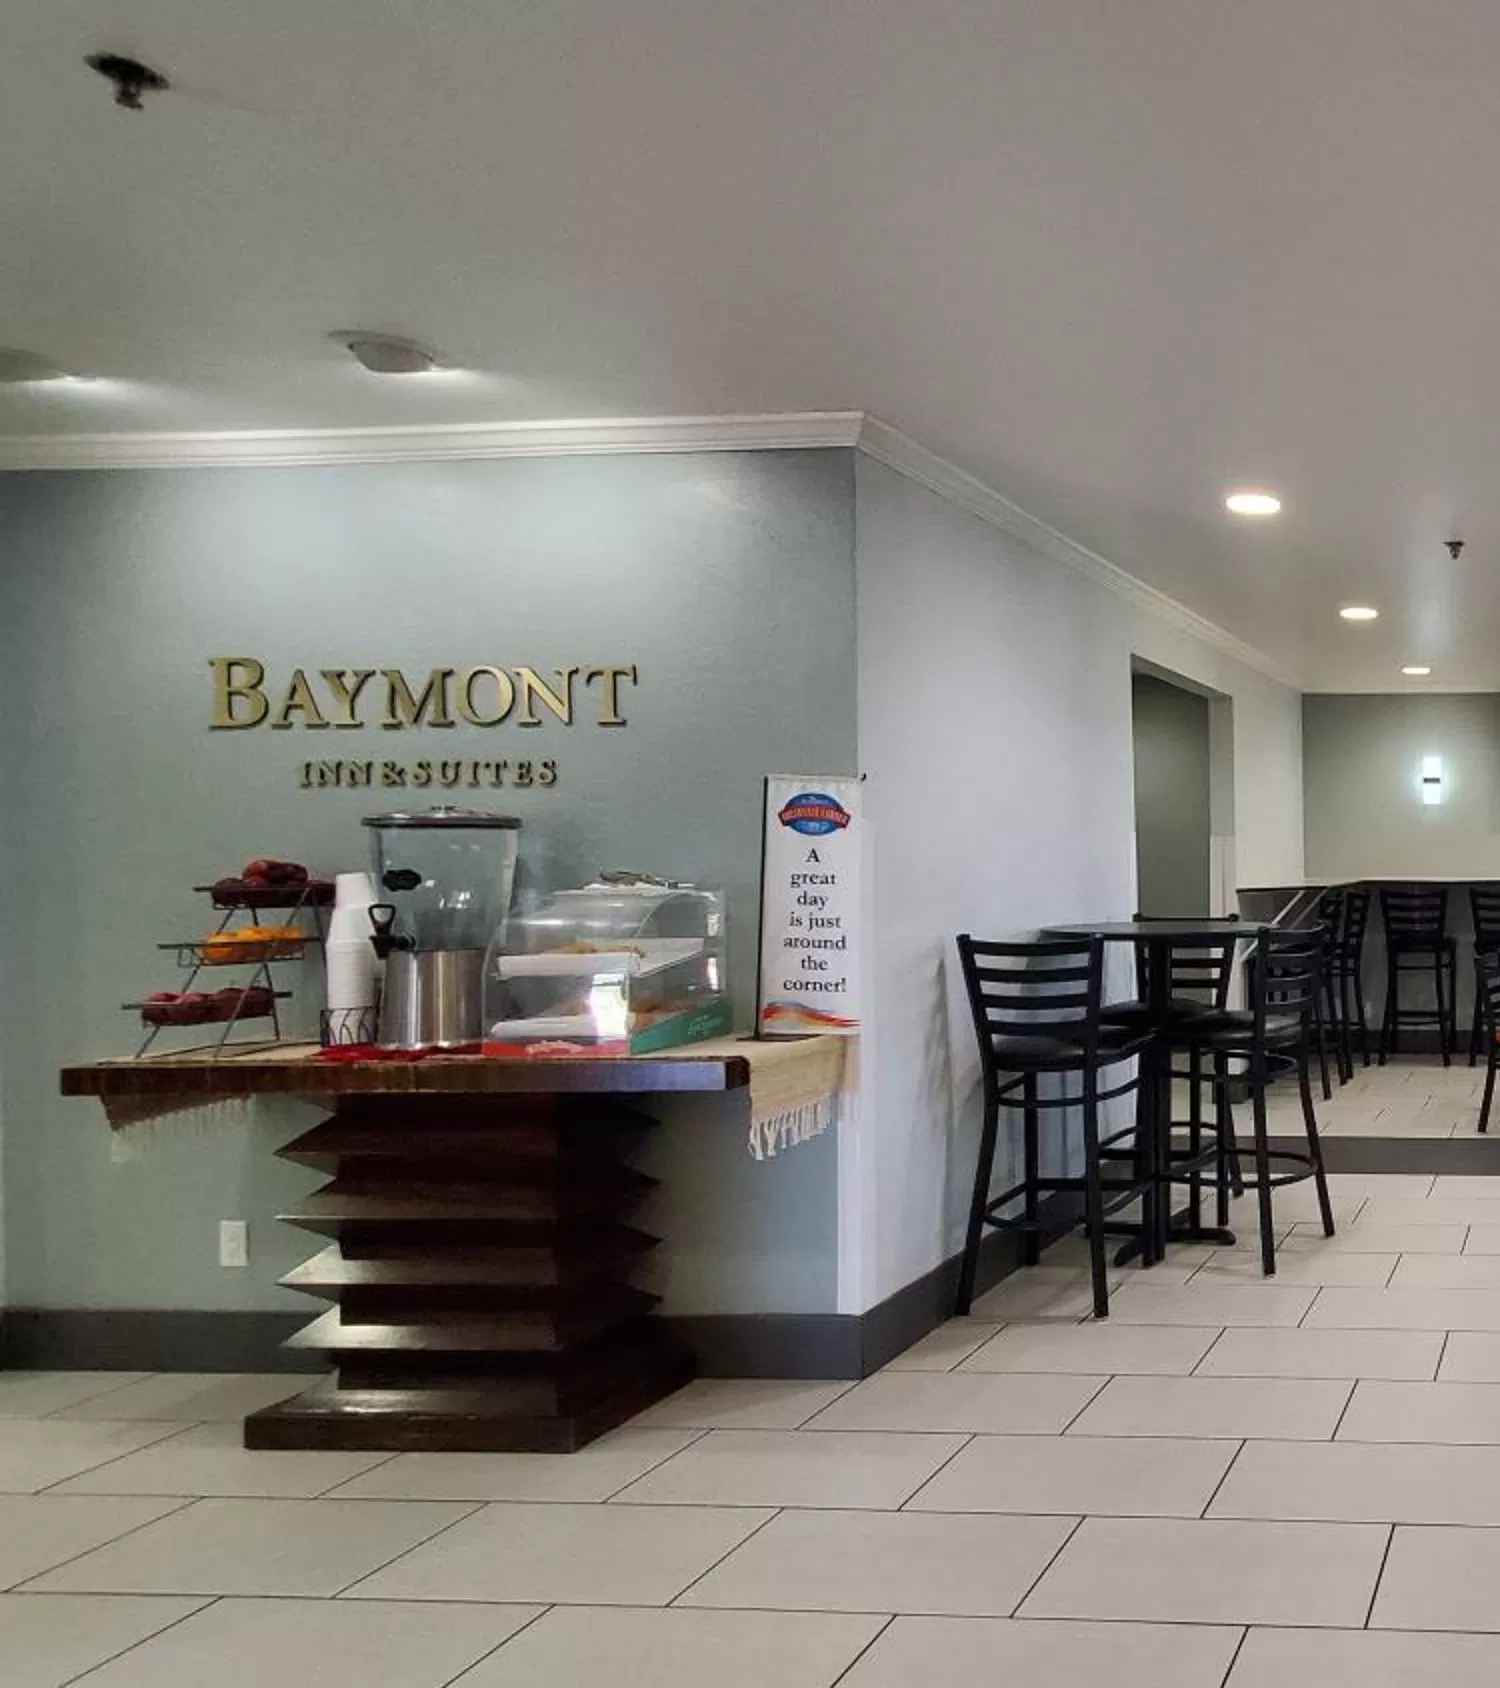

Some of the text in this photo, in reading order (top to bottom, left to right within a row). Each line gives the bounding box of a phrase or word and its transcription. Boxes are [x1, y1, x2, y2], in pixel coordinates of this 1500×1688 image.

[208, 656, 637, 731] BAYMONT
[805, 848, 820, 863] A
[790, 872, 837, 888] great
[797, 891, 829, 910] day
[789, 912, 841, 931] is just
[783, 935, 847, 950] around
[801, 955, 828, 971] the
[783, 978, 847, 993] corner!
